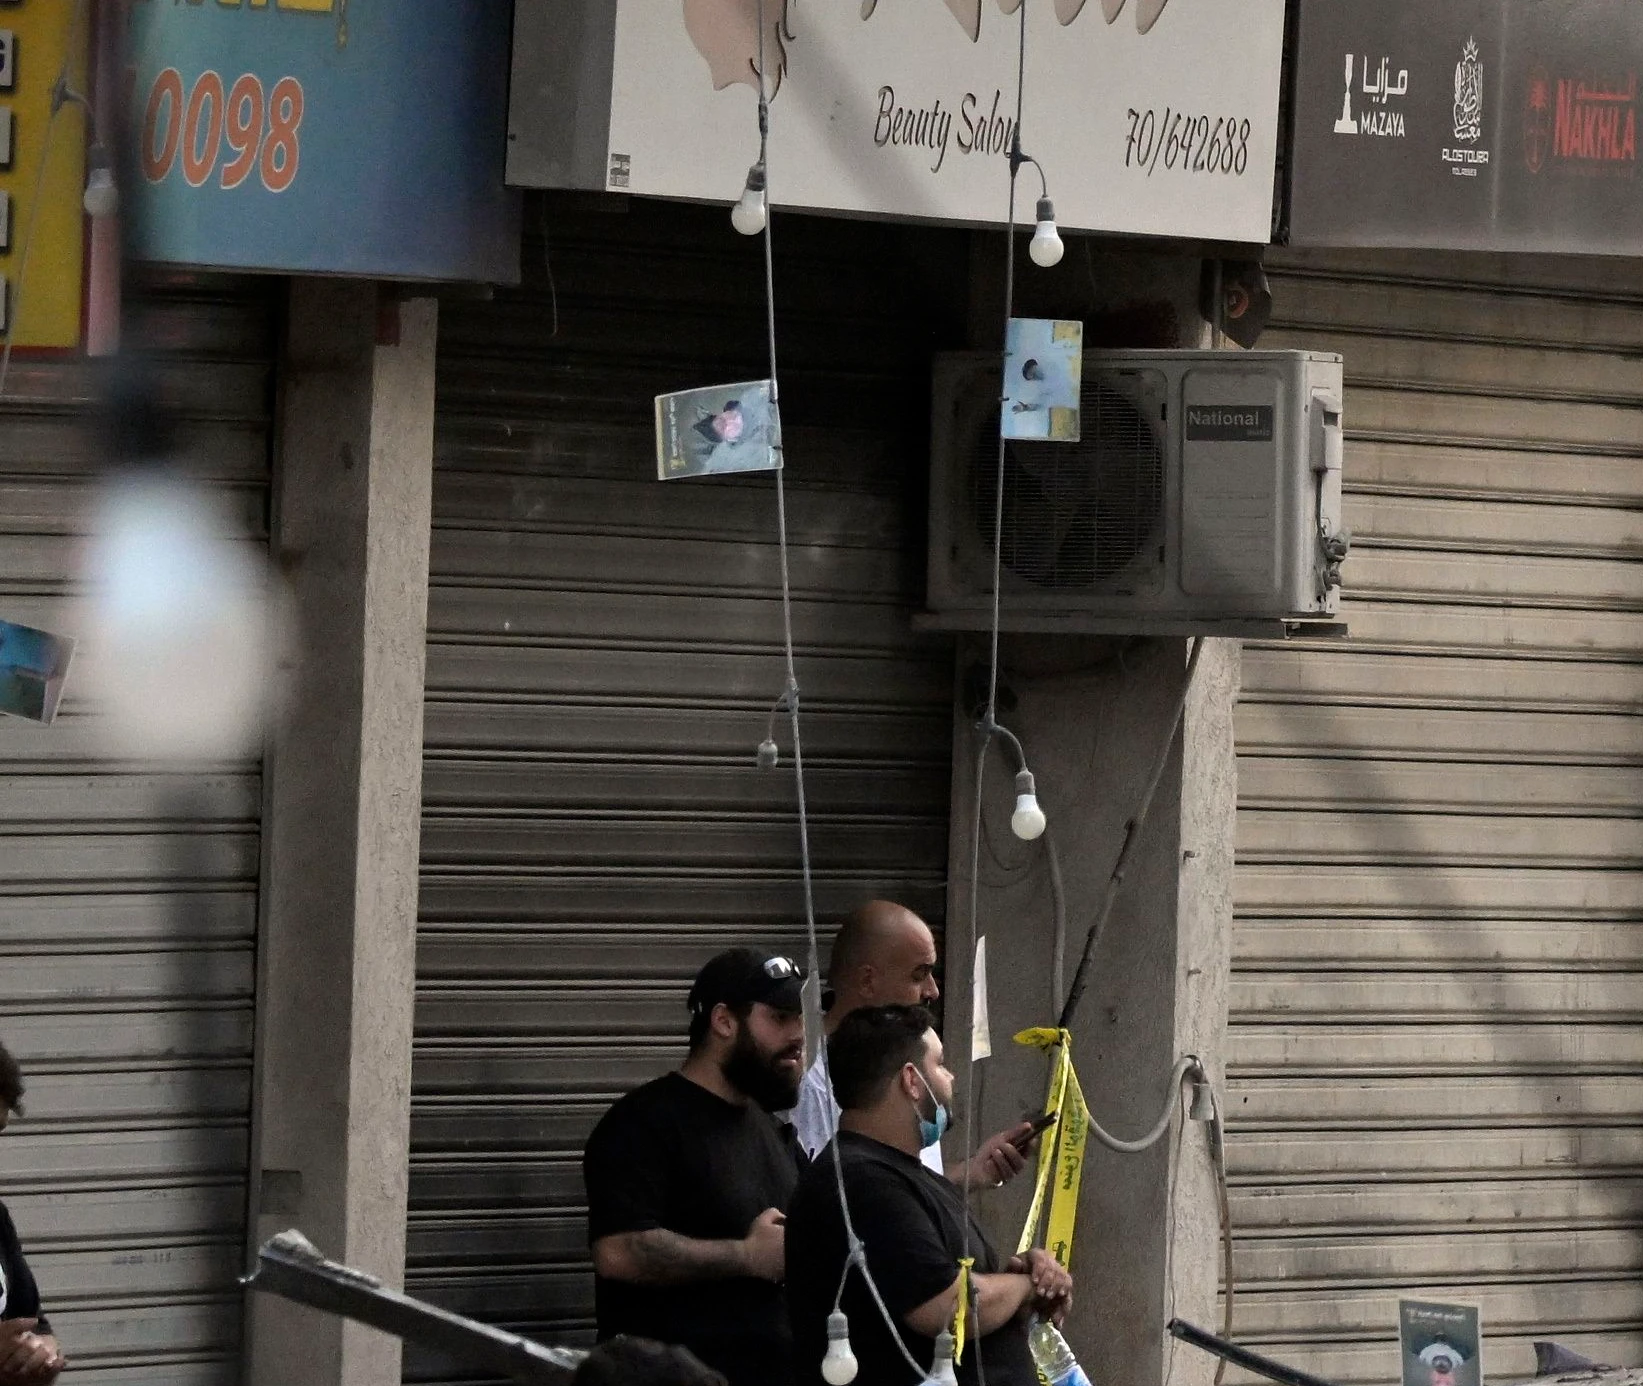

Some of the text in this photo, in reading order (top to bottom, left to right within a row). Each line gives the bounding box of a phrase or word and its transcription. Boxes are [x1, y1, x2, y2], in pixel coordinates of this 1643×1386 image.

[1363, 55, 1408, 104] مزايا
[142, 67, 304, 193] 0098
[874, 86, 1019, 173] Beauty Salon
[1125, 108, 1252, 177] 70/642688
[1361, 111, 1405, 137] MAZAYA
[1189, 409, 1259, 426] National
